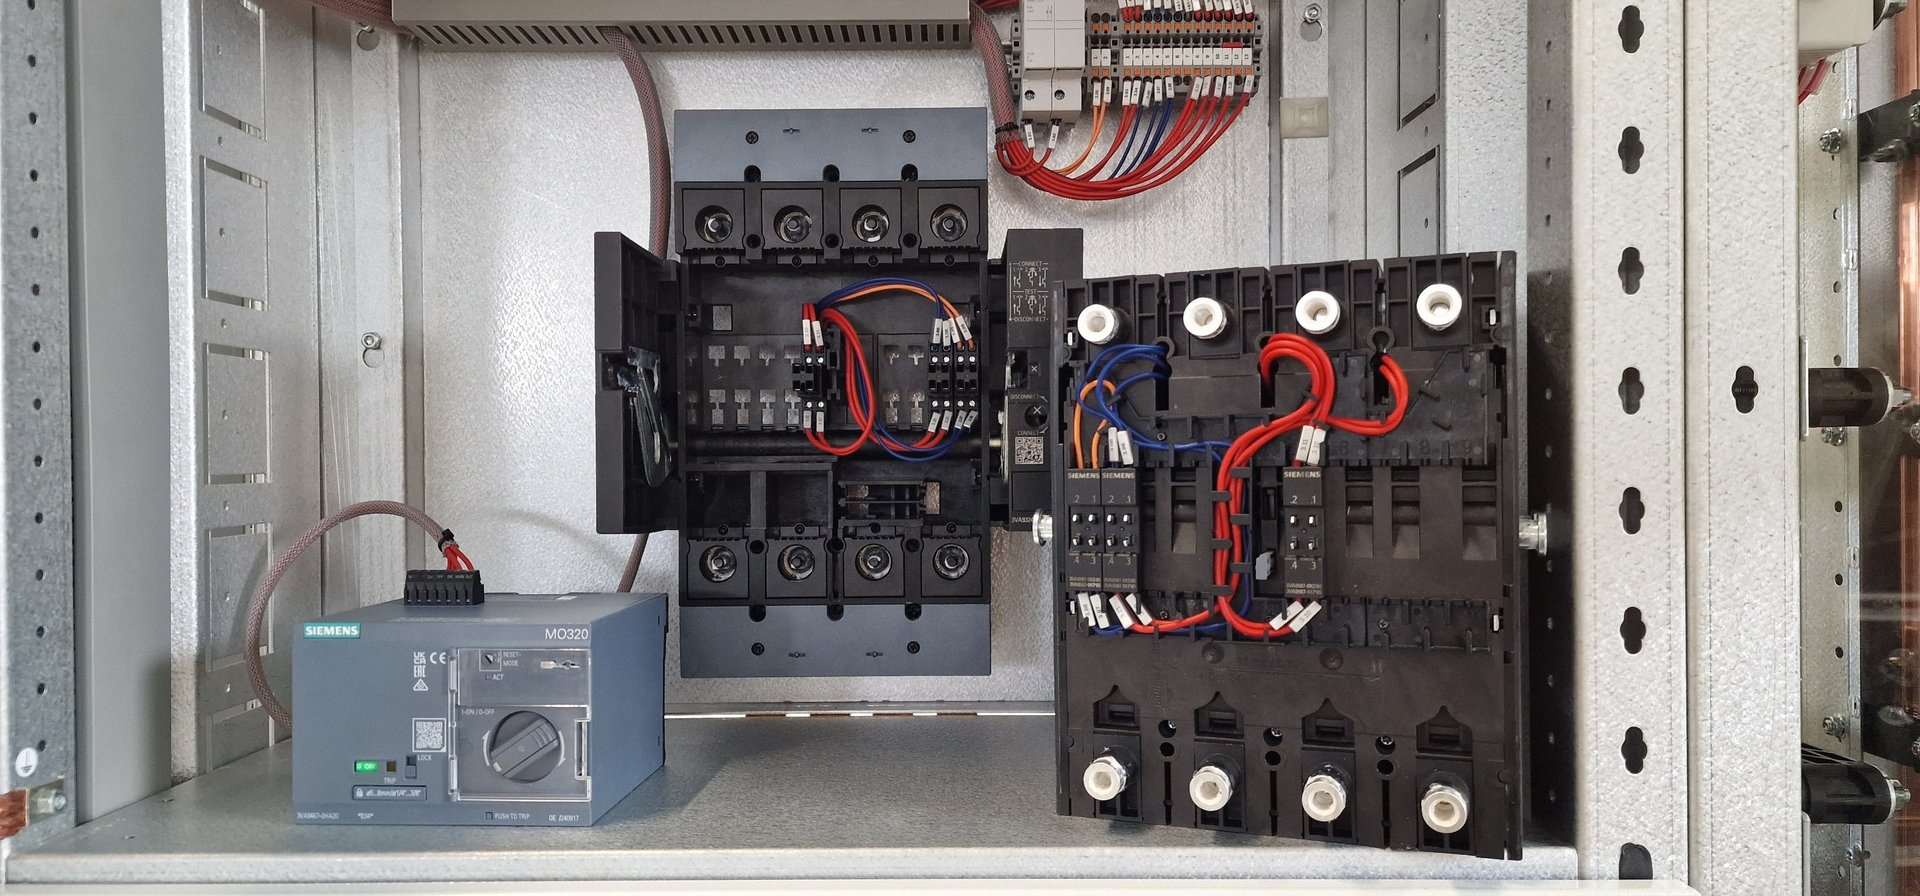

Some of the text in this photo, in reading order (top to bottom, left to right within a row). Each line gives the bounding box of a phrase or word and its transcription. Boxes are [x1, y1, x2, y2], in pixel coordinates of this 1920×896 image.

[305, 626, 358, 636] SIEMENS
[545, 628, 589, 640] MO320
[430, 652, 446, 664] CE
